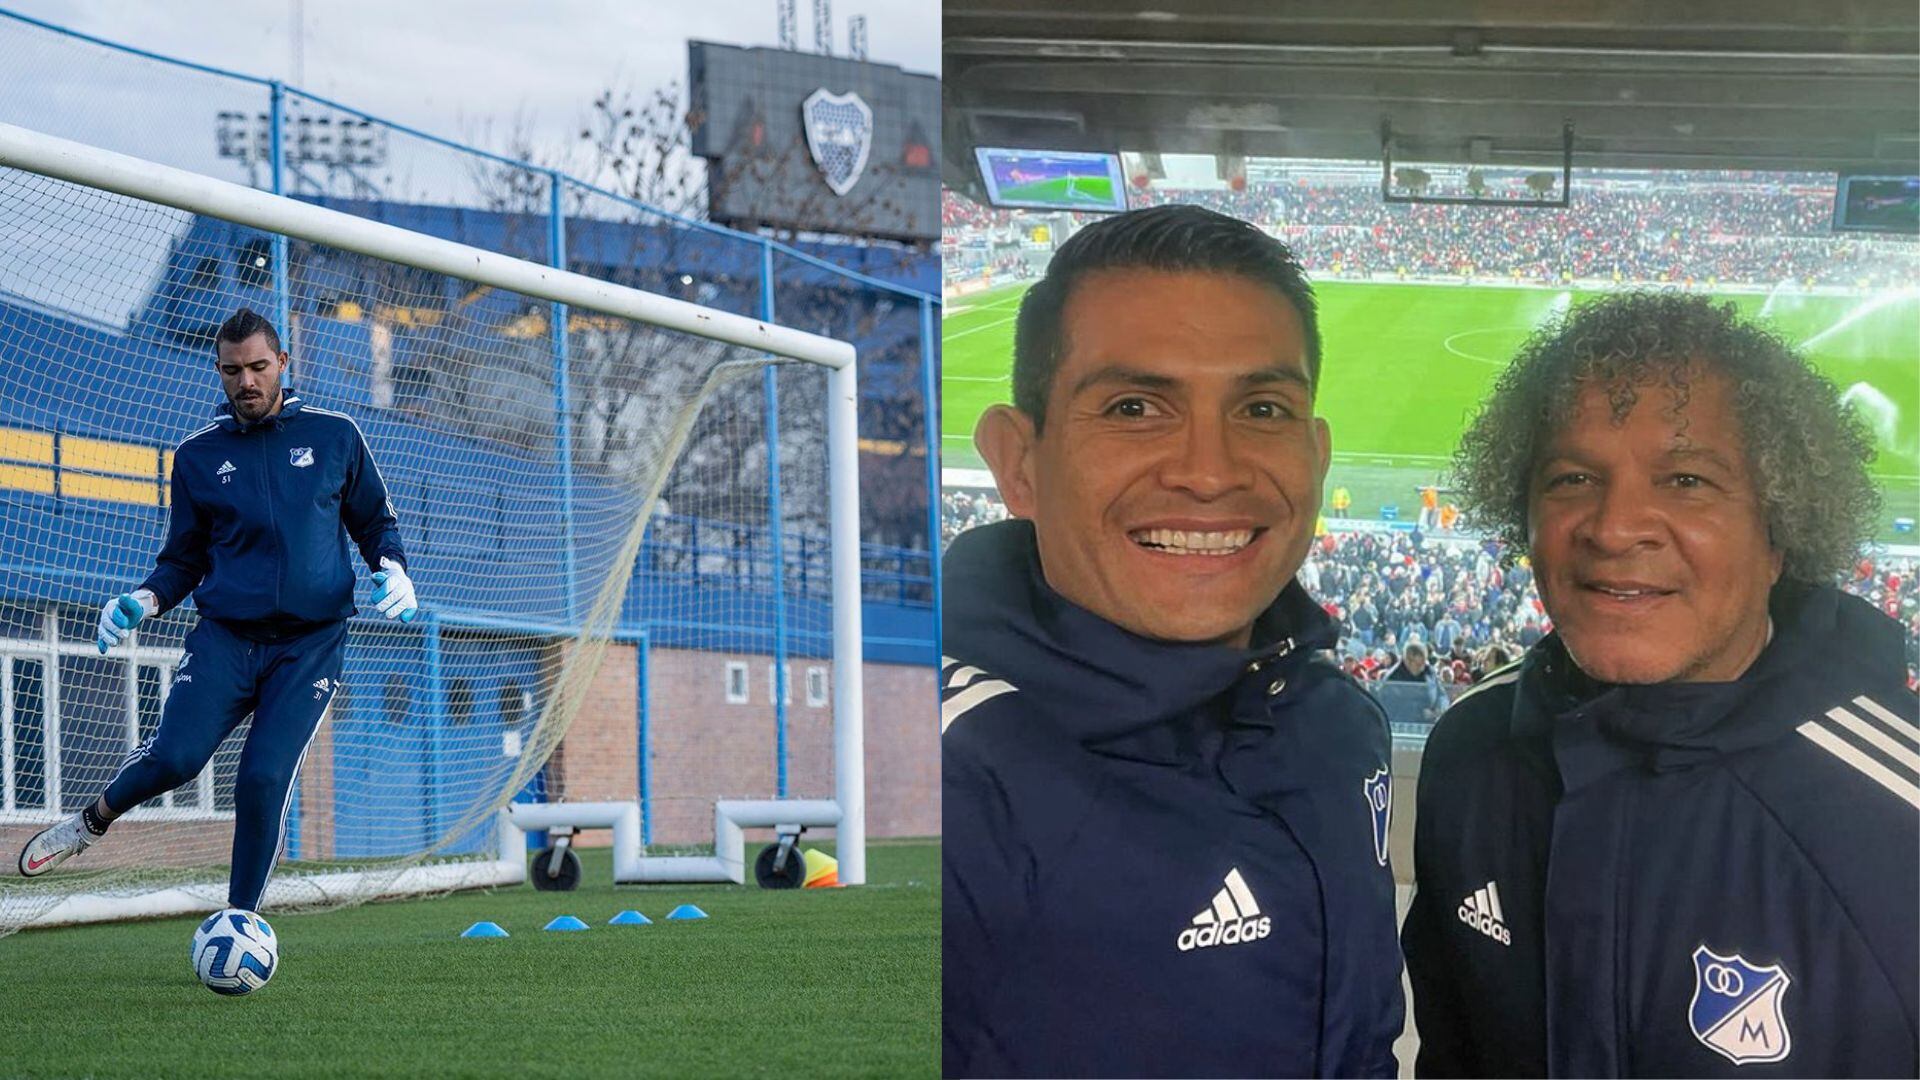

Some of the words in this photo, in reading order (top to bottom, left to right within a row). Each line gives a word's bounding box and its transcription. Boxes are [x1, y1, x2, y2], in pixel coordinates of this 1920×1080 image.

[1177, 916, 1271, 951] adidas
[1457, 905, 1511, 946] adidas
[1739, 1016, 1769, 1049] M
